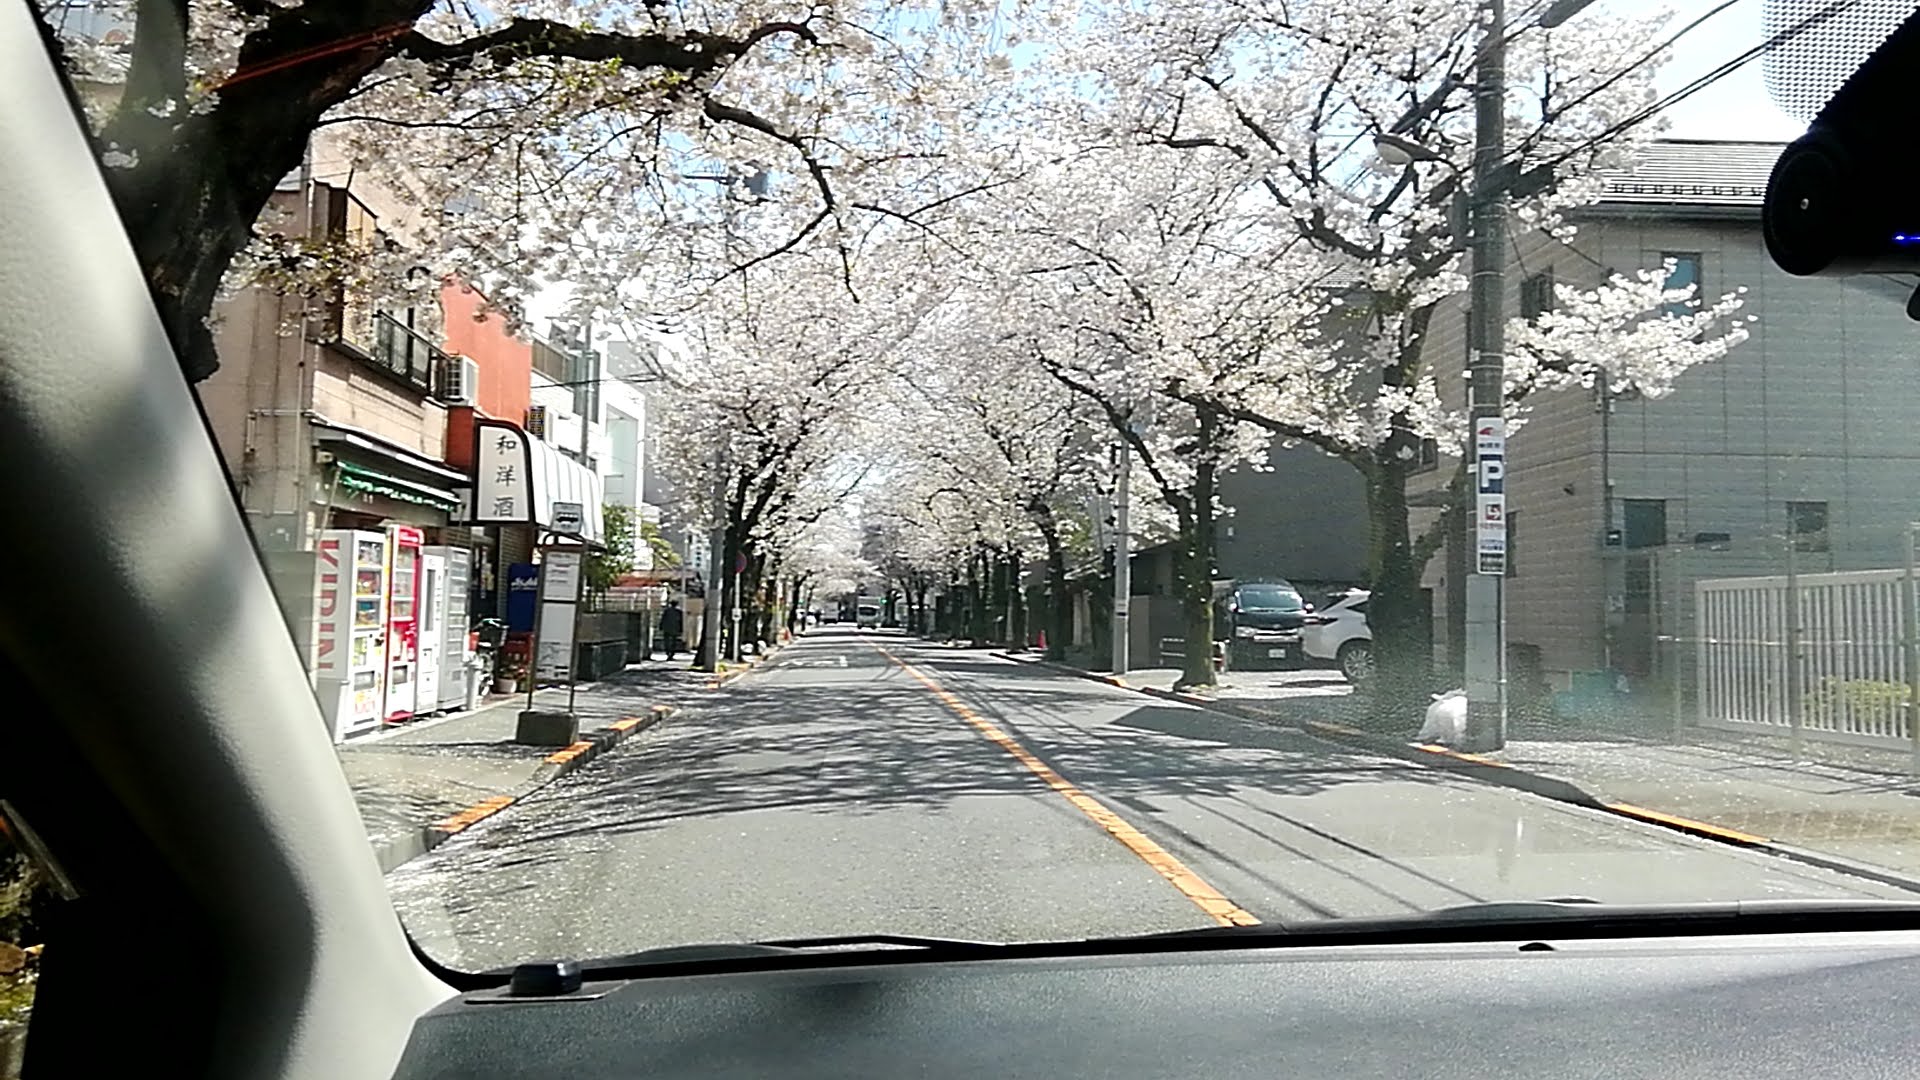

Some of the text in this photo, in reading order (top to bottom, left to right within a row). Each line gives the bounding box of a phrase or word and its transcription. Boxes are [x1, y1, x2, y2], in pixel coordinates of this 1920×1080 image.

[494, 435, 516, 517] 和洋酒
[1481, 460, 1504, 488] P
